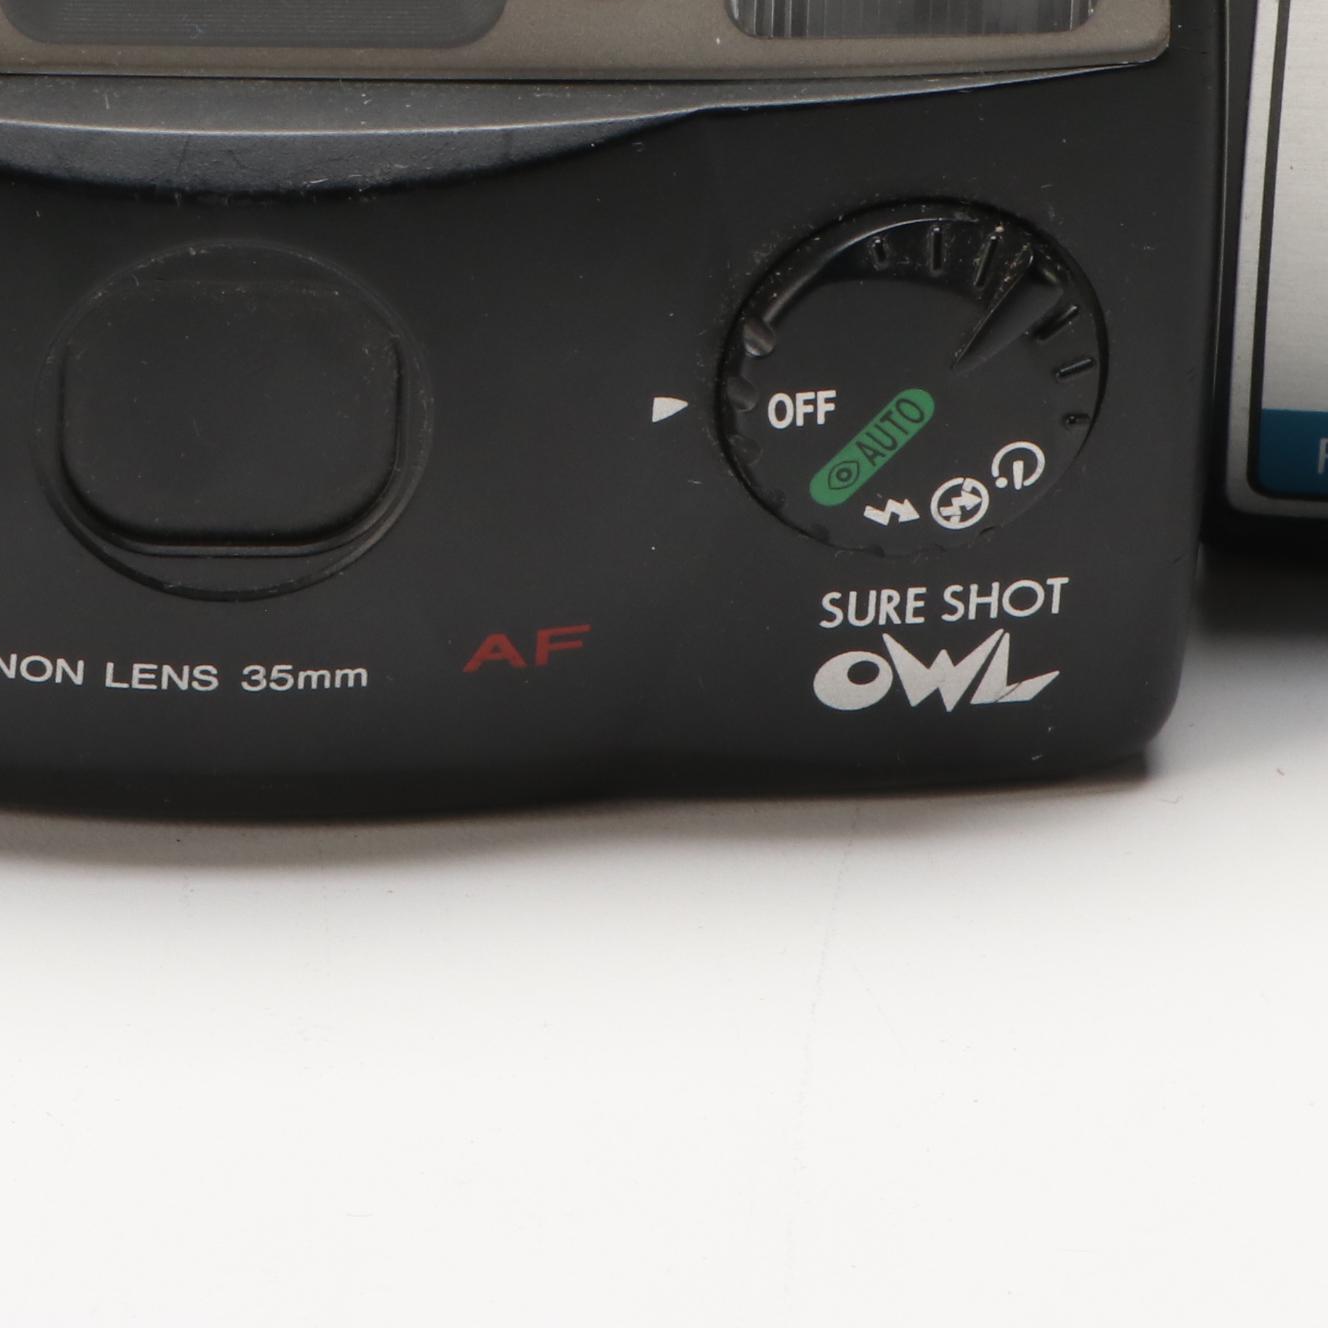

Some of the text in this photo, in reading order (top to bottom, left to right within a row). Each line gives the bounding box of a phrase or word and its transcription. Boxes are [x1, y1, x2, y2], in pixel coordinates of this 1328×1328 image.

[768, 389, 837, 429] OFF
[855, 398, 925, 467] AUTO
[820, 576, 1070, 629] SURE SHOT
[464, 624, 592, 672] AF
[813, 628, 1061, 713] OWL
[105, 662, 219, 692] LENS
[241, 664, 368, 692] 35mm
